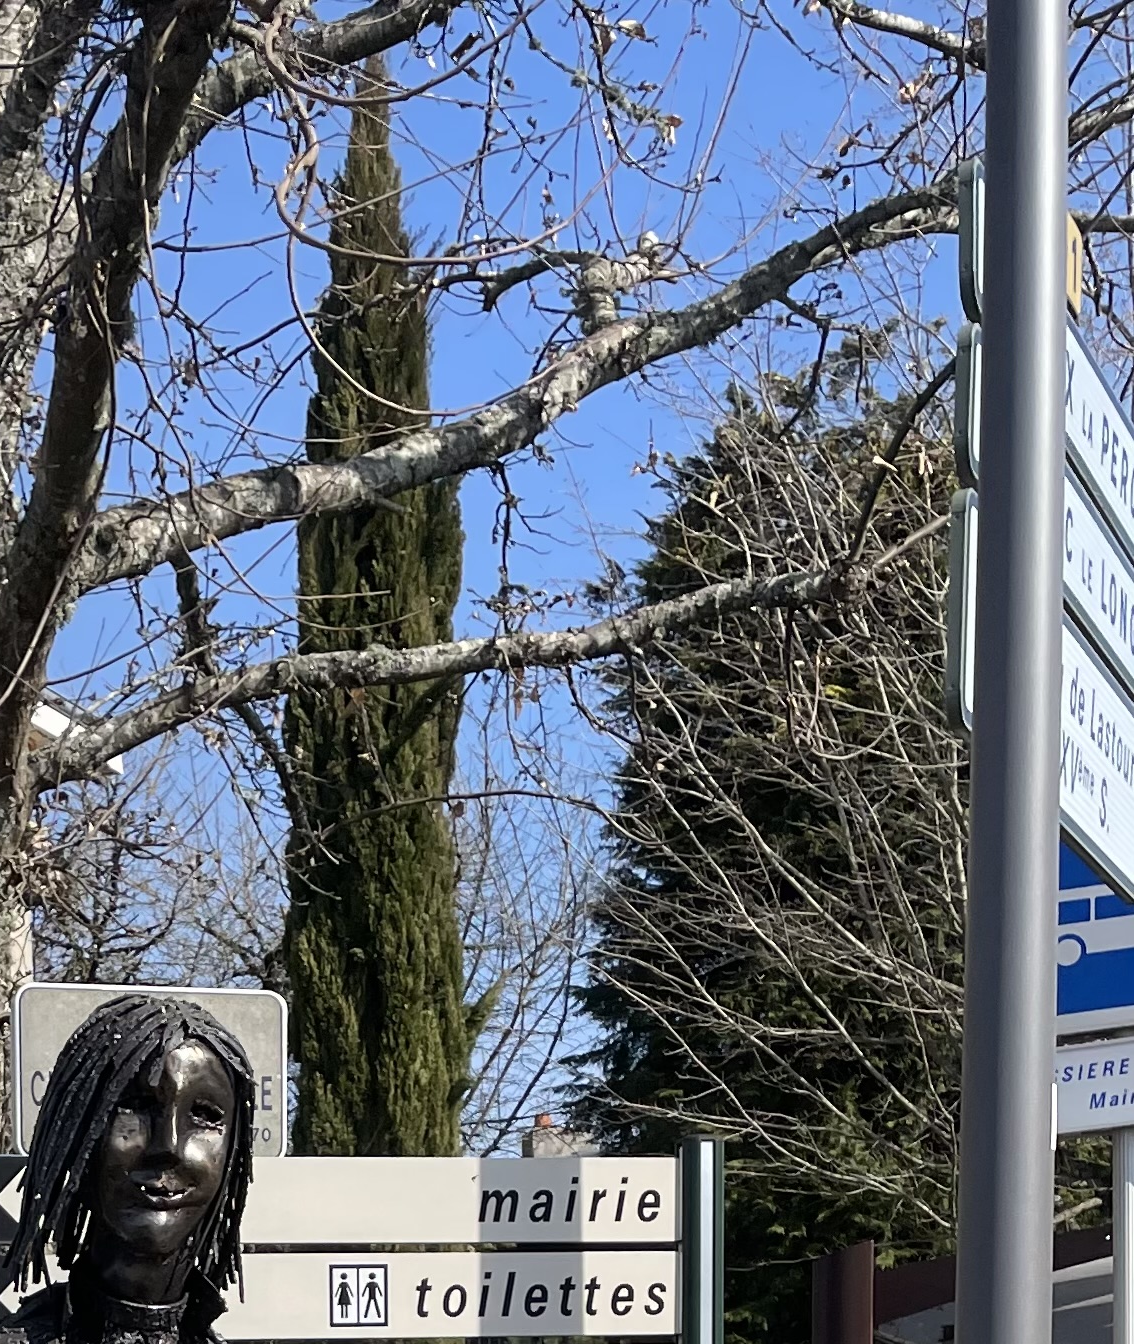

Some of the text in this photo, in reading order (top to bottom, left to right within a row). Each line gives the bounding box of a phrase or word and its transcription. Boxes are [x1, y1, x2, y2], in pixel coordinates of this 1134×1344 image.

[1082, 399, 1093, 449] LA
[1081, 548, 1093, 595] LE
[1069, 667, 1085, 727] de
[1055, 1057, 1130, 1083] SIERE
[478, 1176, 662, 1224] mairie
[415, 1271, 667, 1318] toilettes
